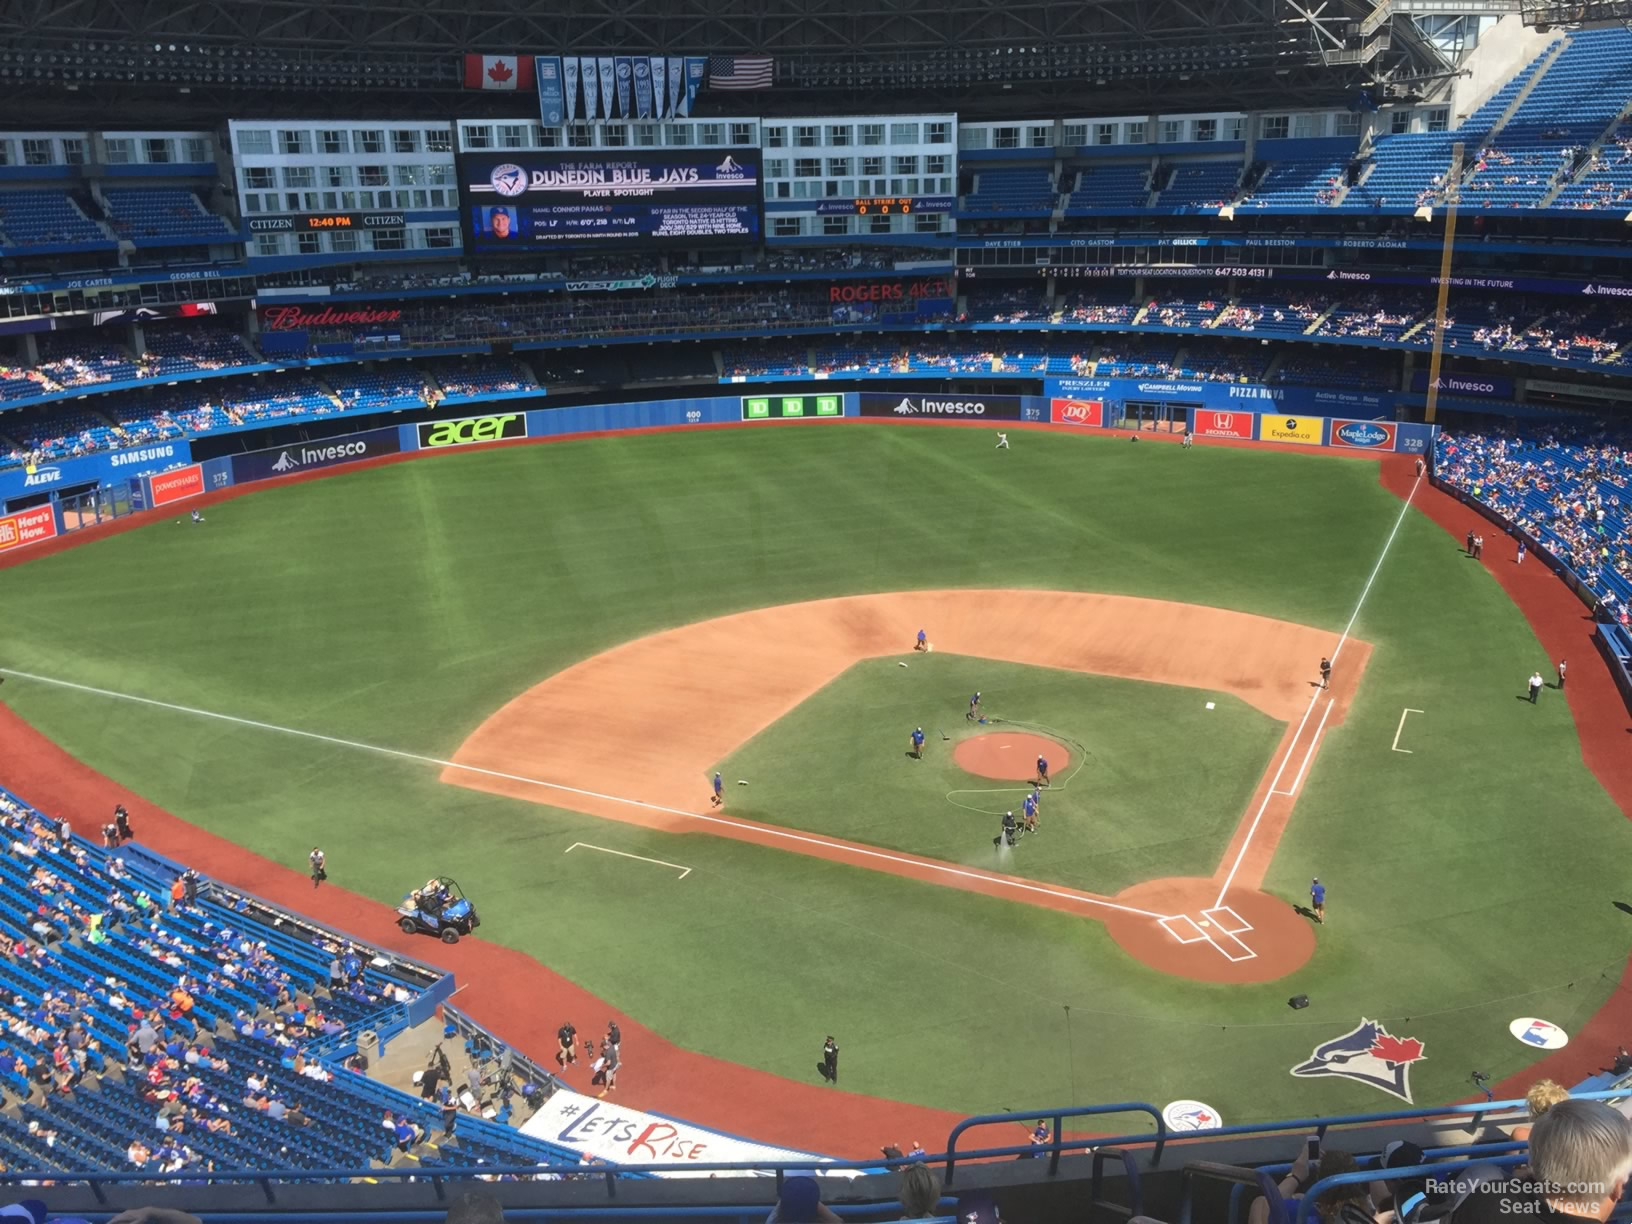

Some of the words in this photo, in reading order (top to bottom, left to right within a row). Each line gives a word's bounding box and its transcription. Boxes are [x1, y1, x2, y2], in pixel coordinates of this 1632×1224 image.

[560, 162, 575, 170] THE
[578, 162, 602, 170] FARM
[606, 161, 637, 169] REPORT
[532, 170, 605, 185] DUNEDIN
[613, 169, 651, 184] BLUE
[659, 168, 699, 183] JAYS
[614, 189, 654, 197] SPOTLIGHT
[860, 206, 867, 214] 0
[882, 205, 889, 214] 0
[903, 205, 910, 213] 0
[250, 219, 293, 229] CITIZEN
[308, 217, 334, 227] 12:40
[335, 217, 350, 226] PM
[364, 215, 404, 225] CITIZEN
[170, 272, 200, 280] GEORGE
[204, 270, 221, 278] BELL
[1128, 268, 1142, 276] YOUR
[1153, 268, 1177, 276] LOCATION
[1181, 268, 1206, 276] QUESTION
[1214, 267, 1231, 277] 647
[1232, 267, 1247, 277] 503
[1248, 267, 1265, 277] 4131
[1340, 271, 1371, 281] Invesco
[67, 280, 83, 289] JOE
[85, 278, 113, 287] CARTER
[1430, 276, 1464, 285] INVESTING
[1465, 278, 1472, 286] IN
[1473, 279, 1486, 287] THE
[1487, 279, 1514, 288] FUTURE
[830, 284, 903, 303] ROGERS
[910, 282, 931, 297] 4K
[1598, 285, 1632, 296] Invesco
[265, 305, 401, 330] Budweiser
[1058, 380, 1110, 388] PRESZLER
[1144, 383, 1176, 391] CAMPBELL
[1176, 384, 1203, 392] MOVING
[1449, 378, 1494, 392] Invesco
[1229, 386, 1258, 398] PIZZA
[1260, 387, 1284, 400] NOVA
[751, 401, 768, 414] TD
[784, 400, 801, 413] TD
[818, 399, 836, 411] TD
[921, 398, 985, 414] Invesco
[686, 410, 701, 418] 400
[1025, 408, 1040, 417] 375
[1066, 405, 1087, 419] DQ
[428, 415, 516, 446] acer
[1205, 429, 1240, 437] HONDA
[1404, 438, 1423, 448] 328
[111, 445, 174, 467] SAMSUNG
[301, 440, 366, 466] Invesco
[24, 470, 62, 487] ALEVE
[212, 472, 228, 483] 375
[18, 513, 50, 528] Here's
[19, 526, 45, 540] How.
